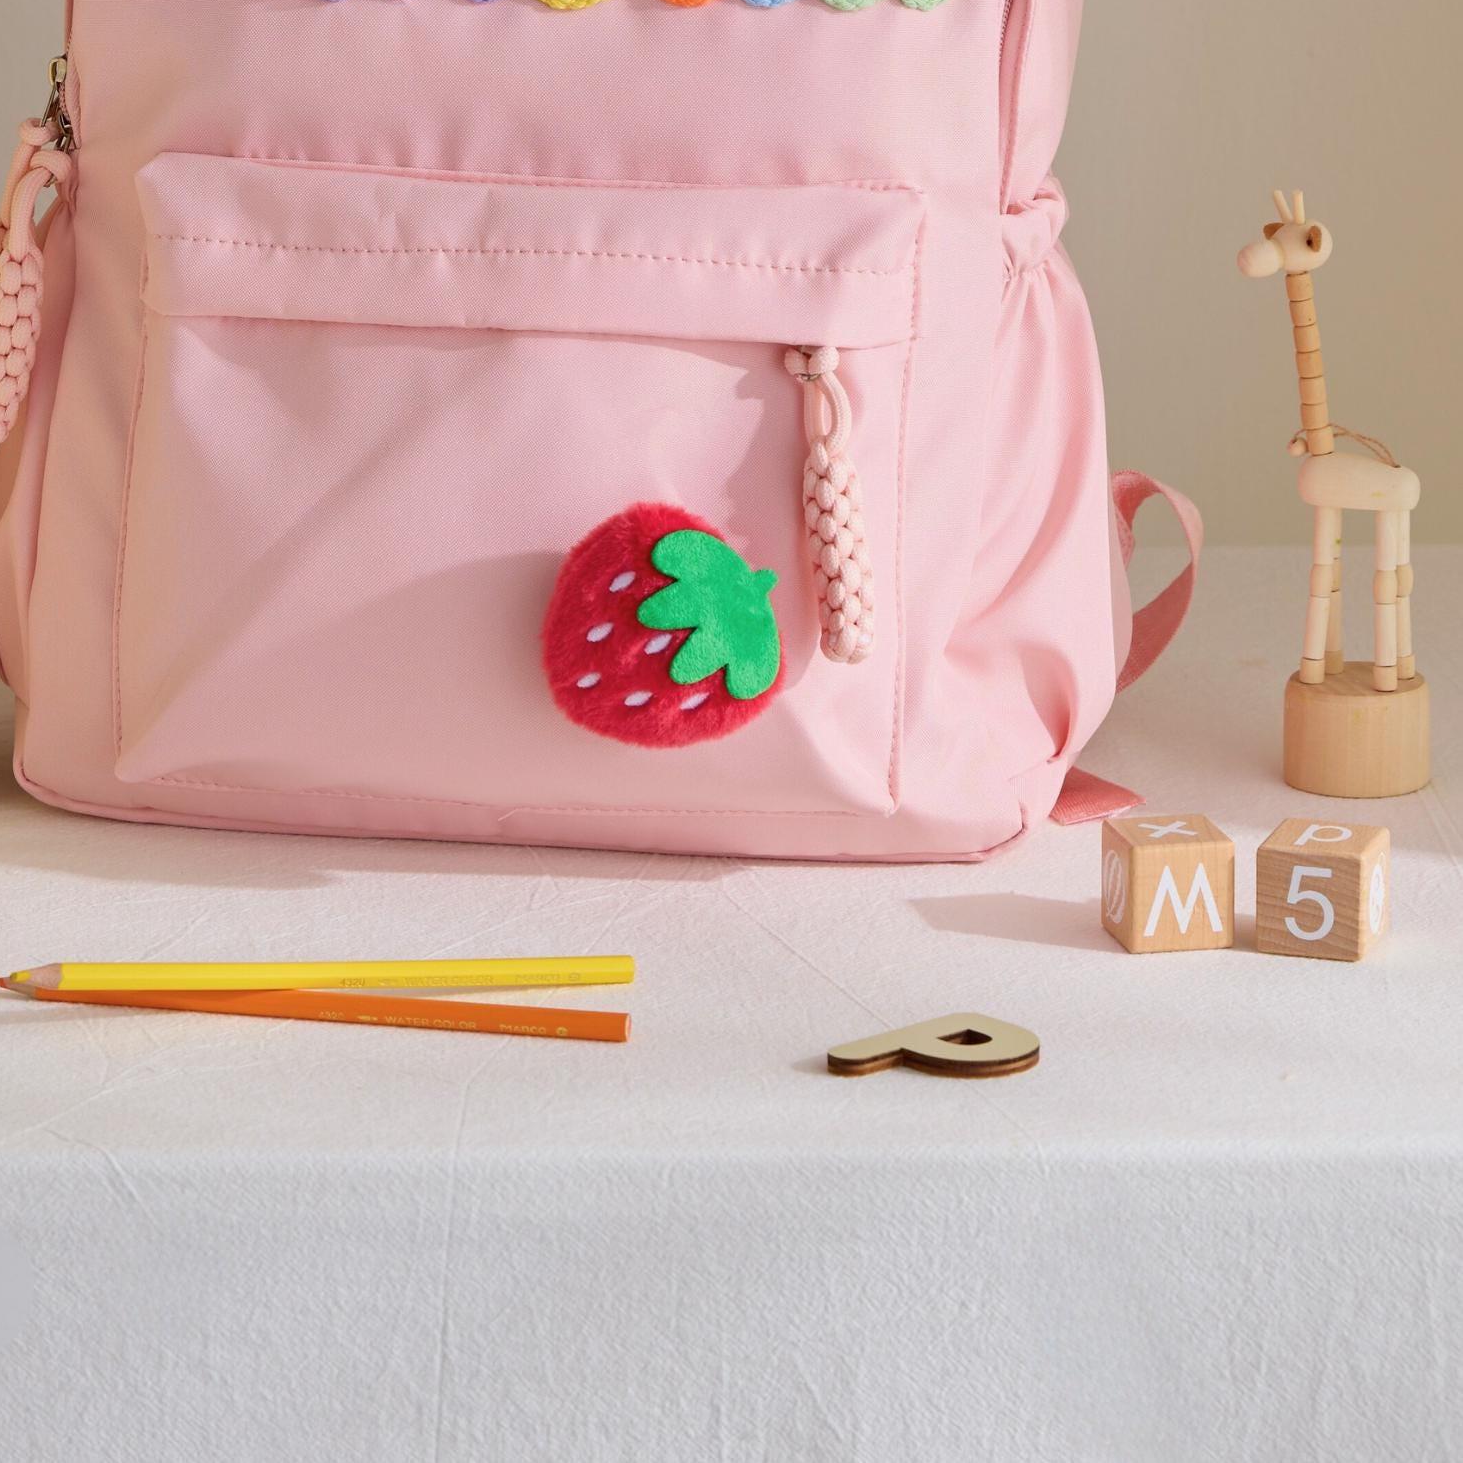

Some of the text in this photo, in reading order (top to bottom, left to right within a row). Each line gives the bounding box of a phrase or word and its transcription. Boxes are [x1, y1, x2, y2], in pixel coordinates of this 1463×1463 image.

[1143, 862, 1224, 937] M
[1284, 865, 1334, 941] 5
[384, 1015, 429, 1027] WATER
[432, 1018, 478, 1030] COLOR
